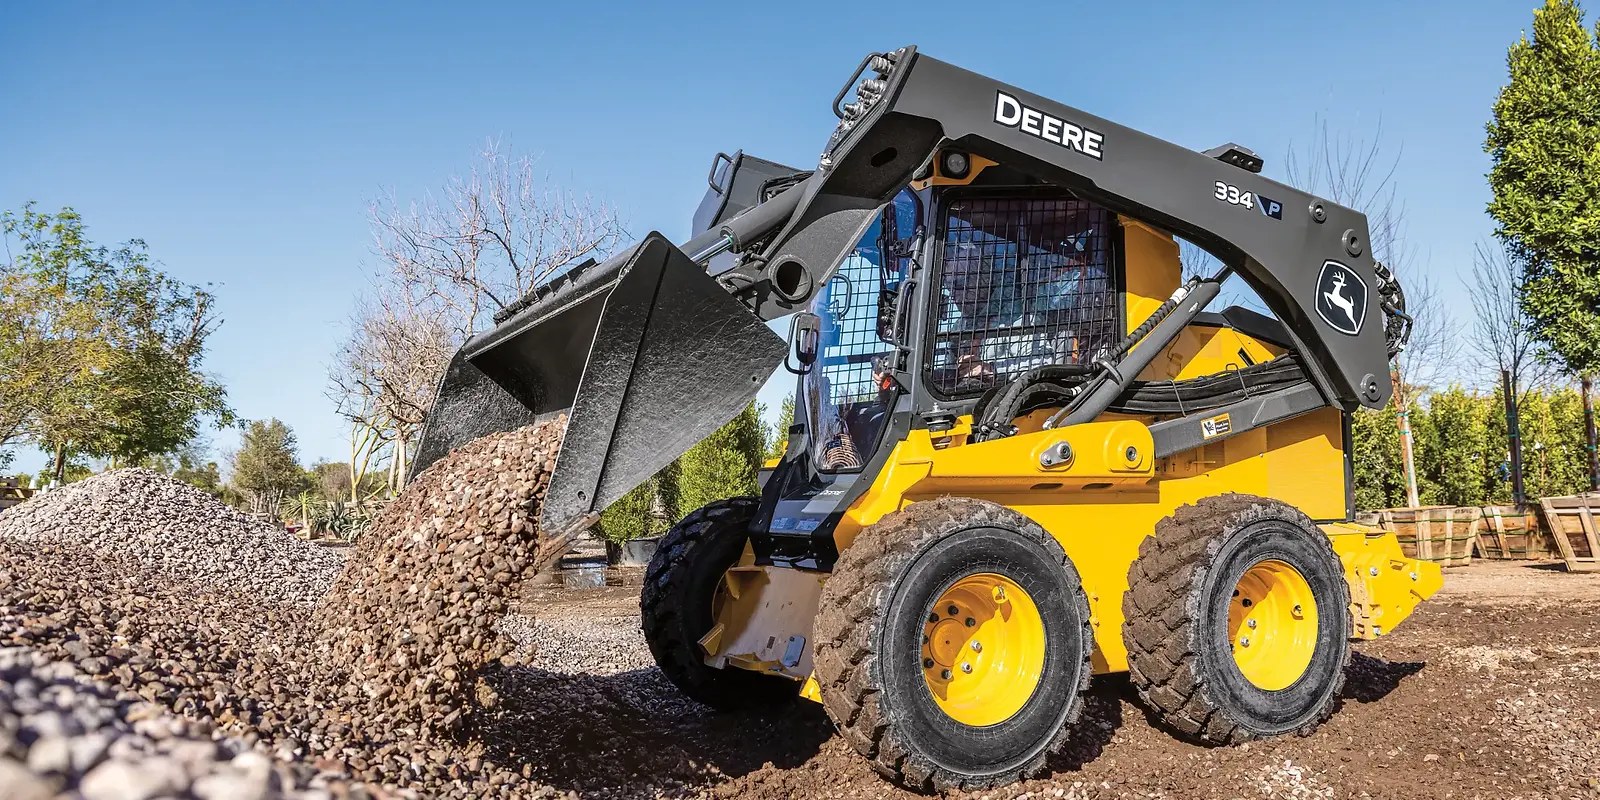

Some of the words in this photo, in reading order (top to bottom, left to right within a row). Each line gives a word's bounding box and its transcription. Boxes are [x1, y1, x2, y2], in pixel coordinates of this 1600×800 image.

[994, 91, 1104, 160] DEERE
[1214, 181, 1254, 210] 334
[1268, 201, 1281, 215] P
